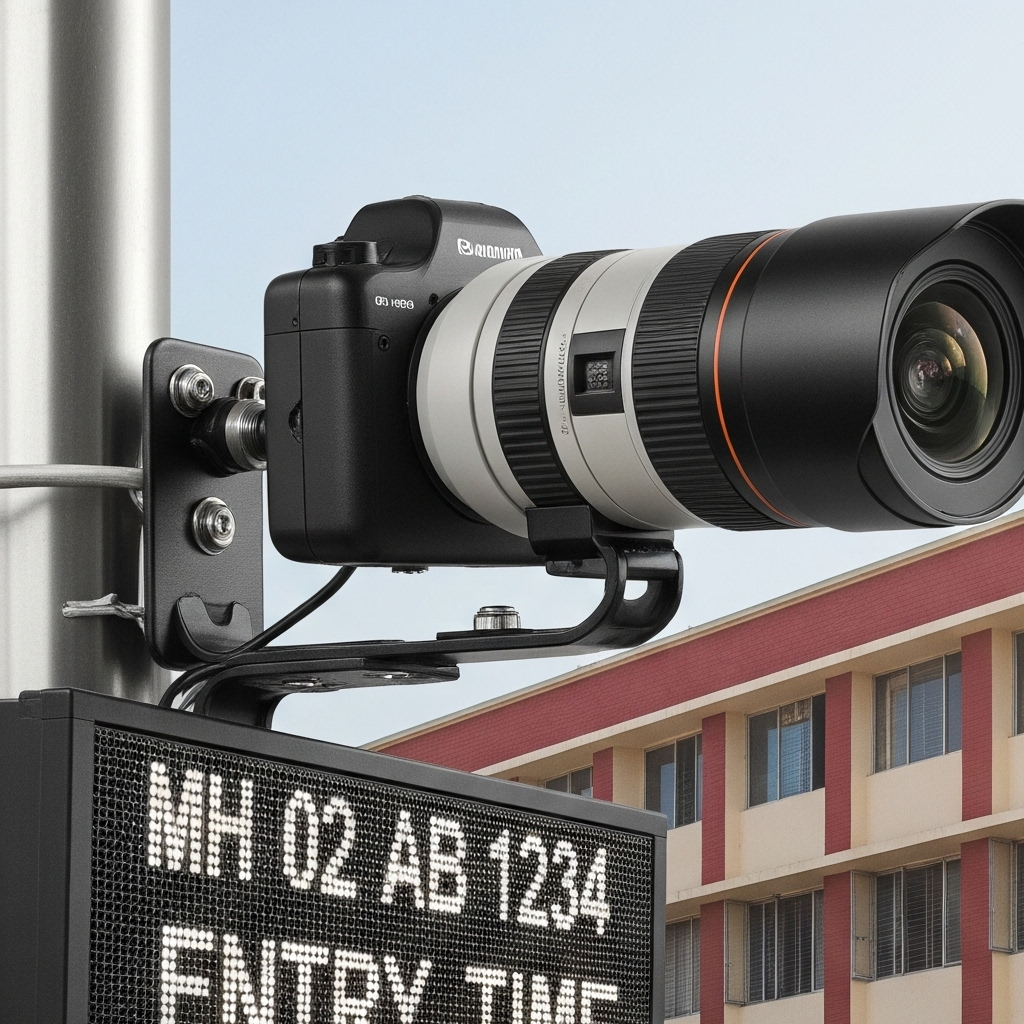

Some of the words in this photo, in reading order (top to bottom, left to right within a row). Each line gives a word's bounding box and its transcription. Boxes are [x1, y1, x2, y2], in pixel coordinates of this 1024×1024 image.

[147, 761, 253, 881] MH
[282, 788, 359, 899] 02
[379, 809, 468, 914] AB
[489, 828, 612, 935] 1234
